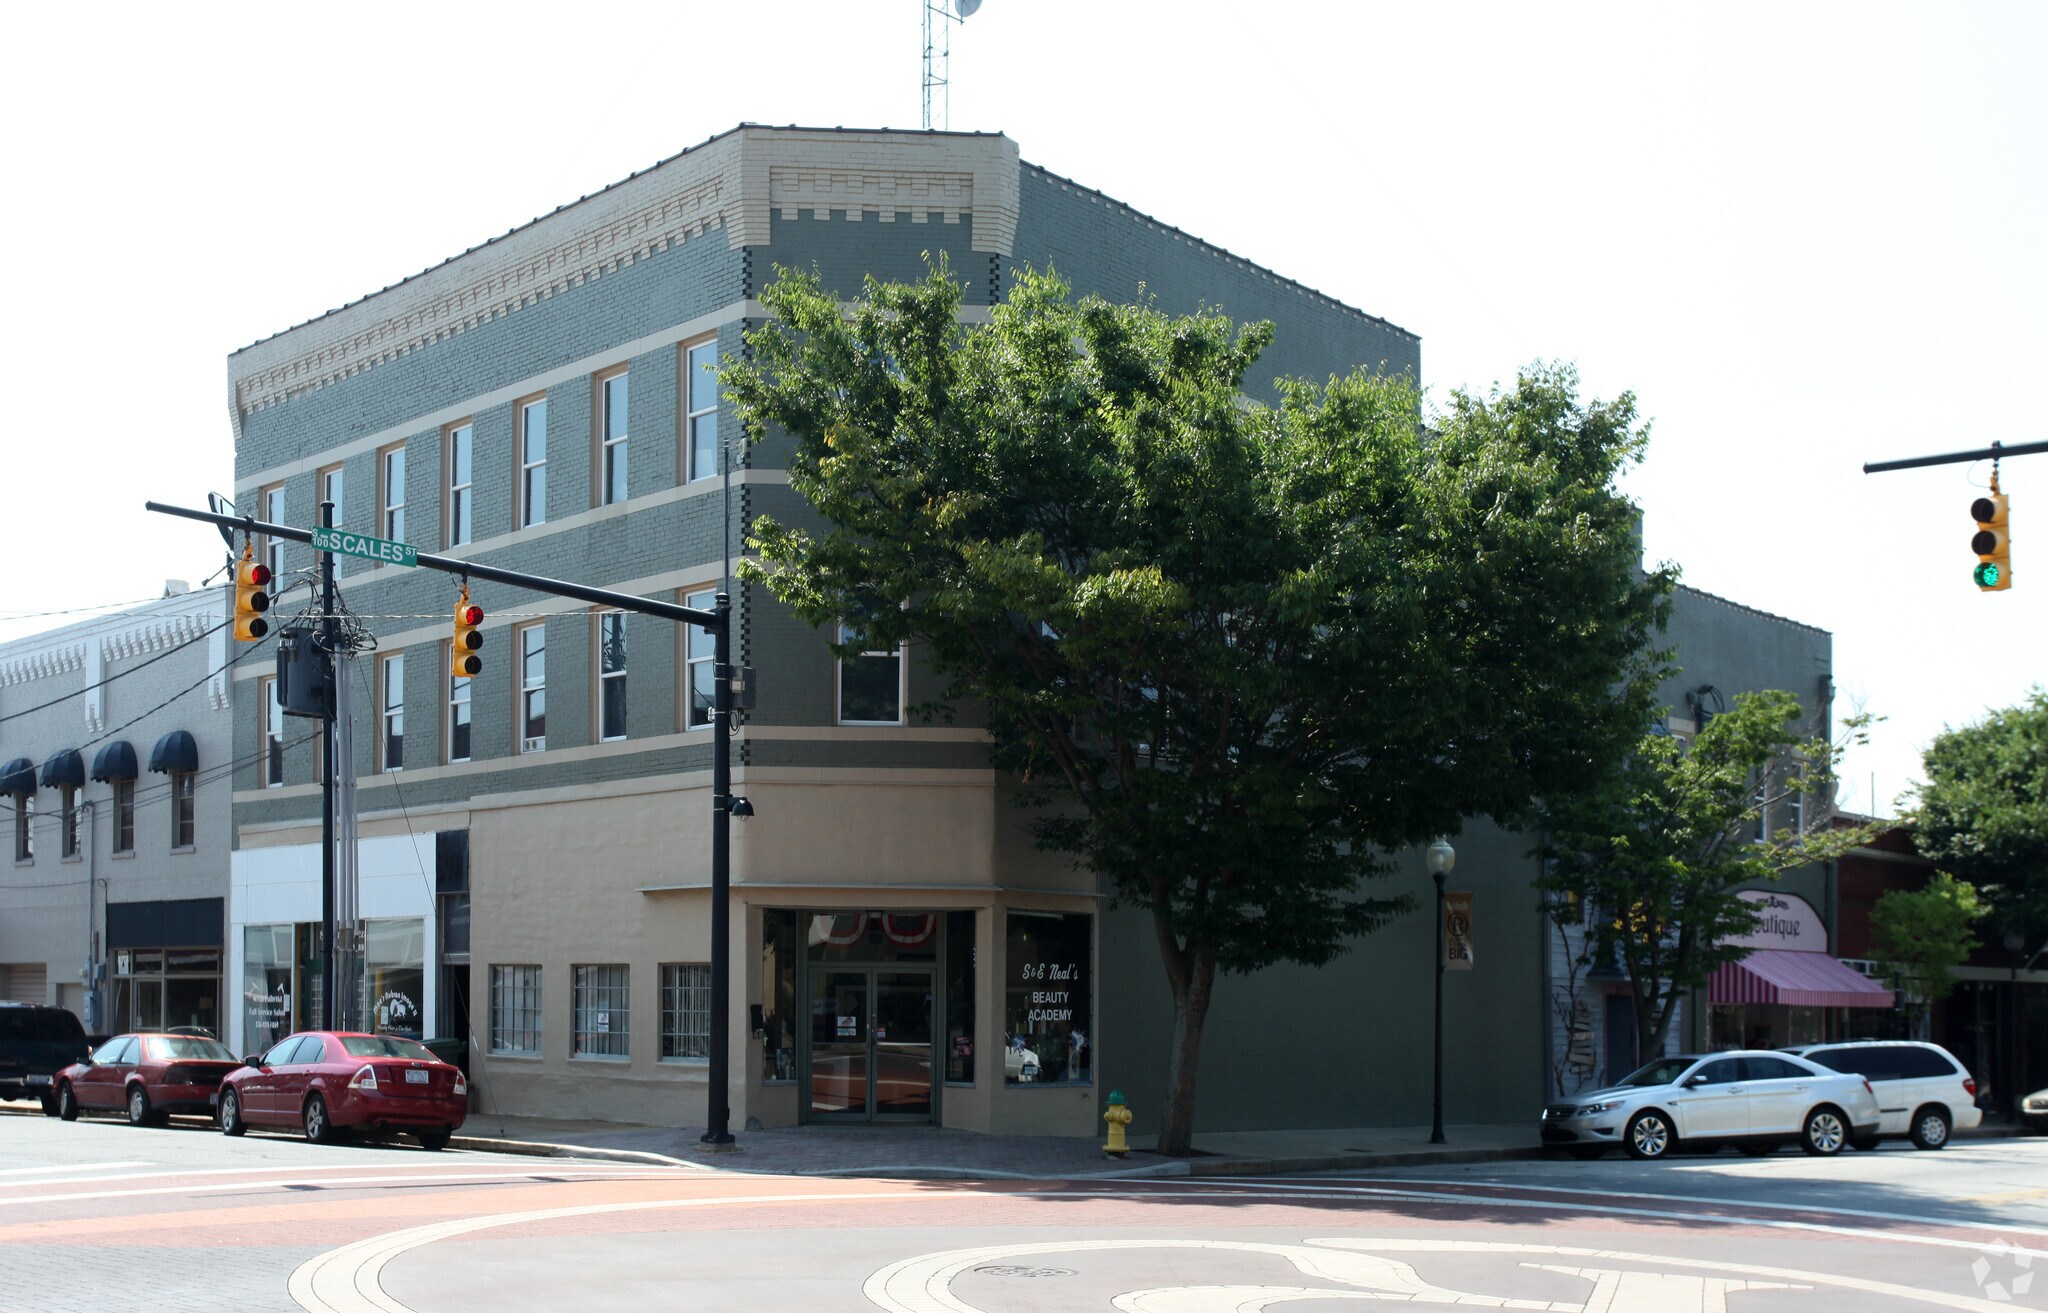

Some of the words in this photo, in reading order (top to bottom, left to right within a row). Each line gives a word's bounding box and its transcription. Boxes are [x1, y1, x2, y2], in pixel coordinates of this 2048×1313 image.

[312, 537, 329, 548] 100
[329, 532, 404, 562] SCALES
[405, 546, 417, 556] ST
[1448, 948, 1468, 960] BIG
[1049, 963, 1078, 980] Neal's
[1032, 991, 1069, 1004] BEAUTY
[248, 1007, 258, 1016] Full
[257, 1008, 273, 1016] Service
[1028, 1009, 1073, 1021] ACADEMY
